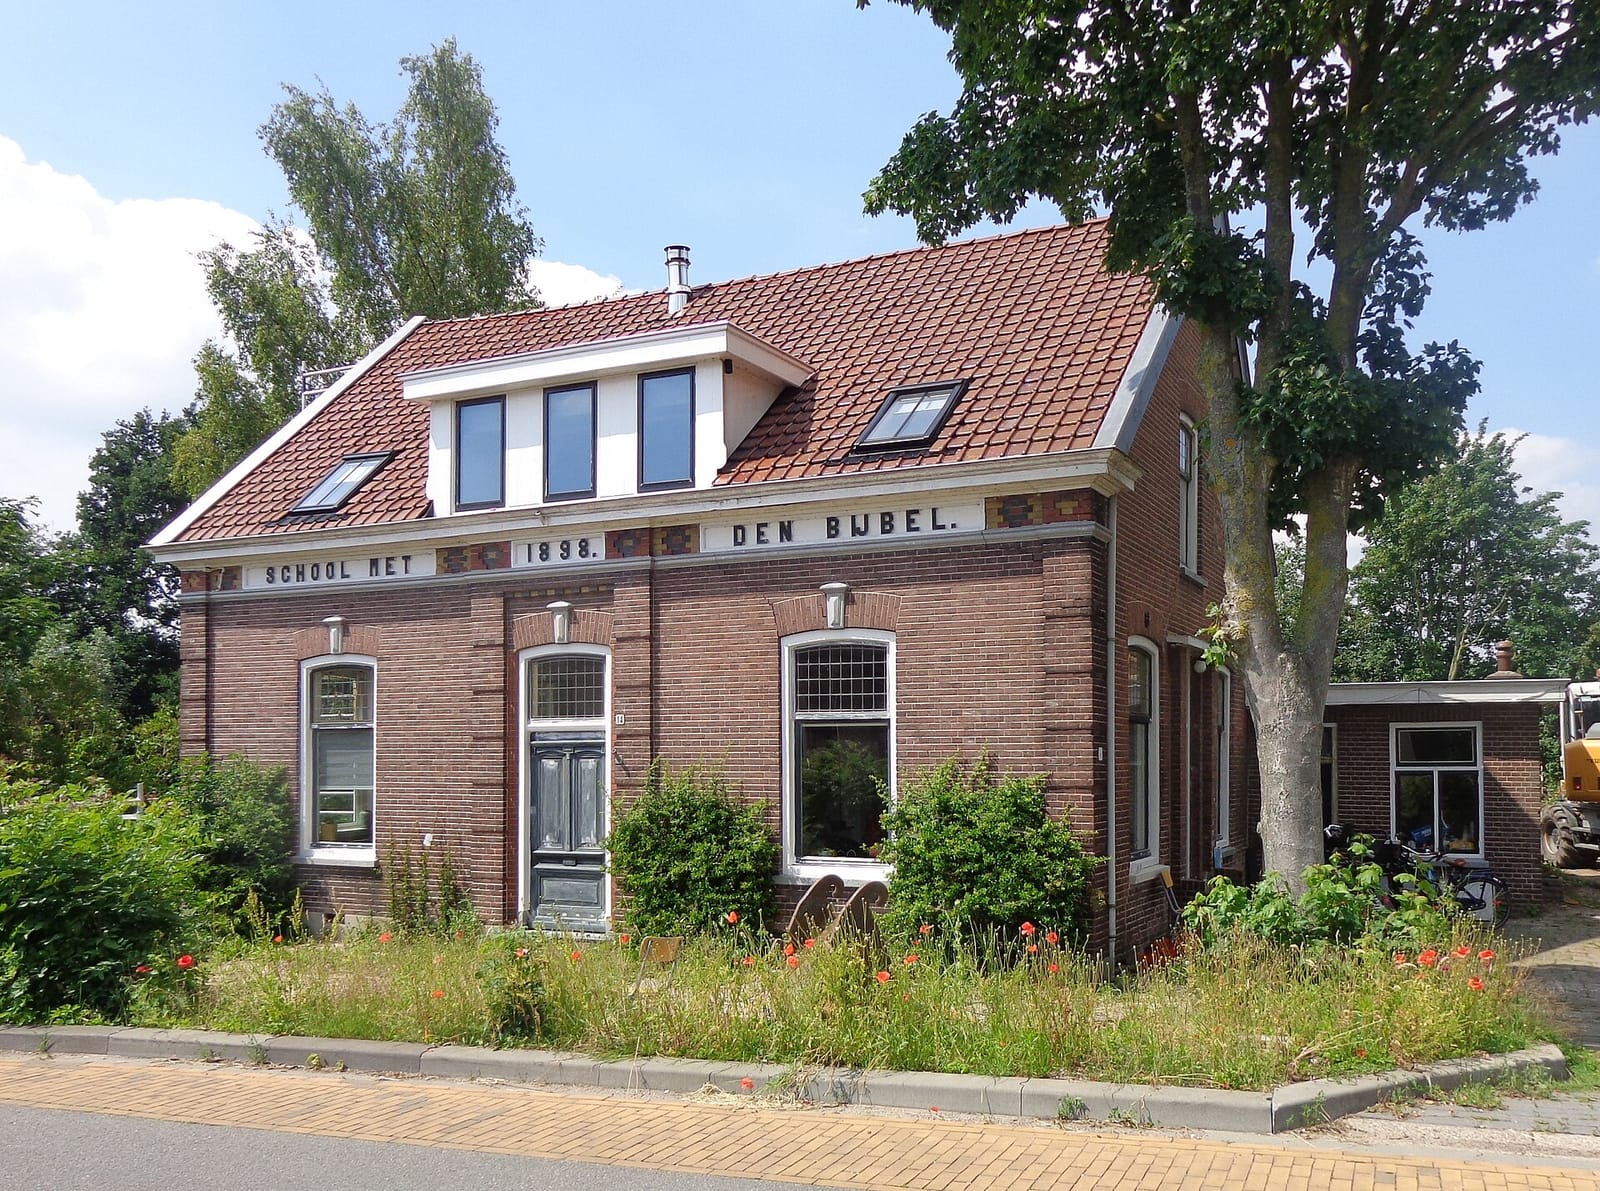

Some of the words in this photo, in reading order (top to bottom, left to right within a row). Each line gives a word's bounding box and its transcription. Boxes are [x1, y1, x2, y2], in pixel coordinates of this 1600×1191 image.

[733, 519, 792, 547] DEN
[527, 538, 597, 563] 1898.
[266, 560, 352, 585] SCHOOL
[369, 554, 412, 577] MET
